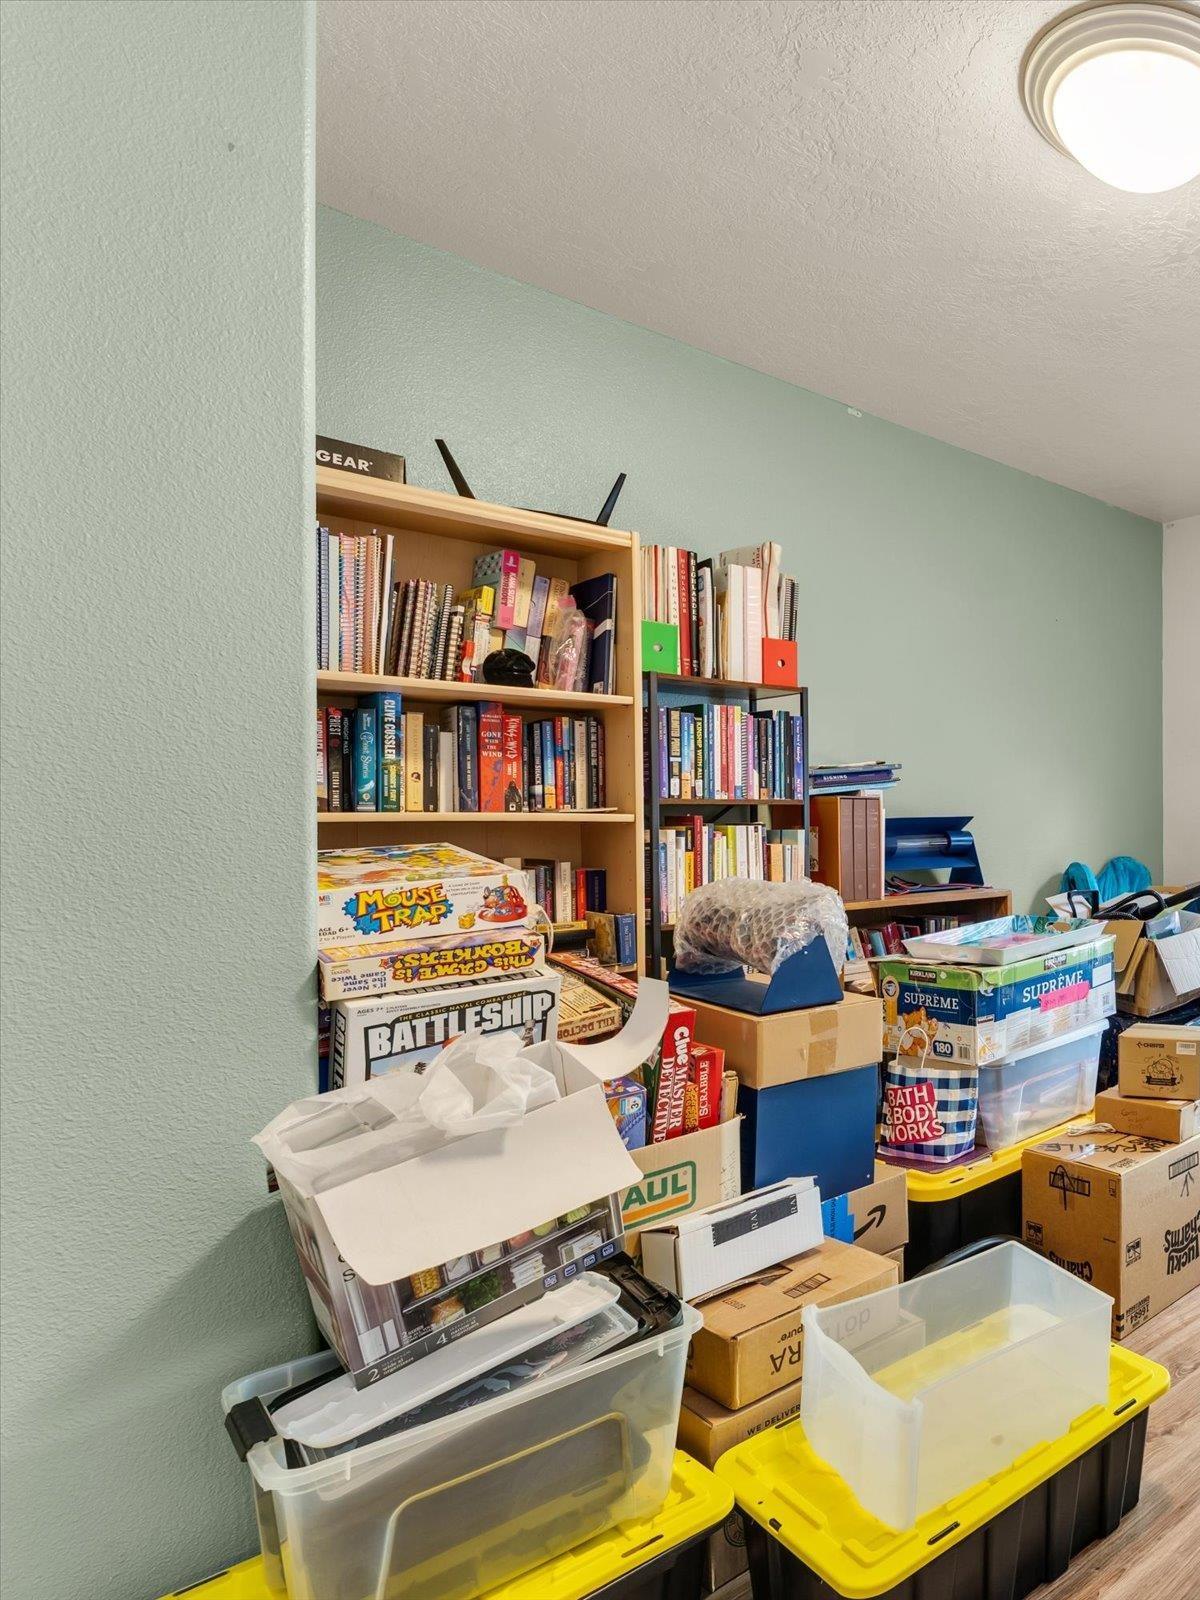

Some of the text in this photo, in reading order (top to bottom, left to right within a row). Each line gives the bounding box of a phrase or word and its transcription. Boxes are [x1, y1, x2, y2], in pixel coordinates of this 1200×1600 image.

[330, 714, 341, 735] PRIEST
[384, 700, 396, 760] CLIVE CUSSLER
[481, 750, 503, 758] WIND
[355, 883, 446, 917] MOUSE
[372, 903, 446, 934] TRAP
[395, 939, 531, 971] BONKERS!
[331, 973, 359, 984] Twice
[360, 970, 388, 980] Game
[392, 955, 534, 984] This GAME is
[909, 970, 937, 979] KIRKLAND
[342, 984, 371, 993] Never
[343, 976, 388, 988] the Same
[904, 991, 960, 1011] SUPRÊME
[399, 1013, 416, 1021] THE
[416, 1007, 447, 1019] CLASSIC
[449, 1003, 475, 1013] NAVAL
[367, 993, 551, 1060] BATTLESHIP
[557, 1021, 596, 1040] DOCTOR
[934, 1041, 952, 1054] 180
[667, 1065, 688, 1129] MASTER
[698, 1060, 710, 1118] SCRABBLE
[888, 1085, 929, 1107] BATH
[652, 1056, 676, 1143] DETECTIVE
[885, 1119, 945, 1142] WORKS
[1167, 1236, 1200, 1276] Lucky
[436, 1332, 448, 1345] 4
[368, 1369, 381, 1382] 2
[747, 1422, 763, 1437] WE
